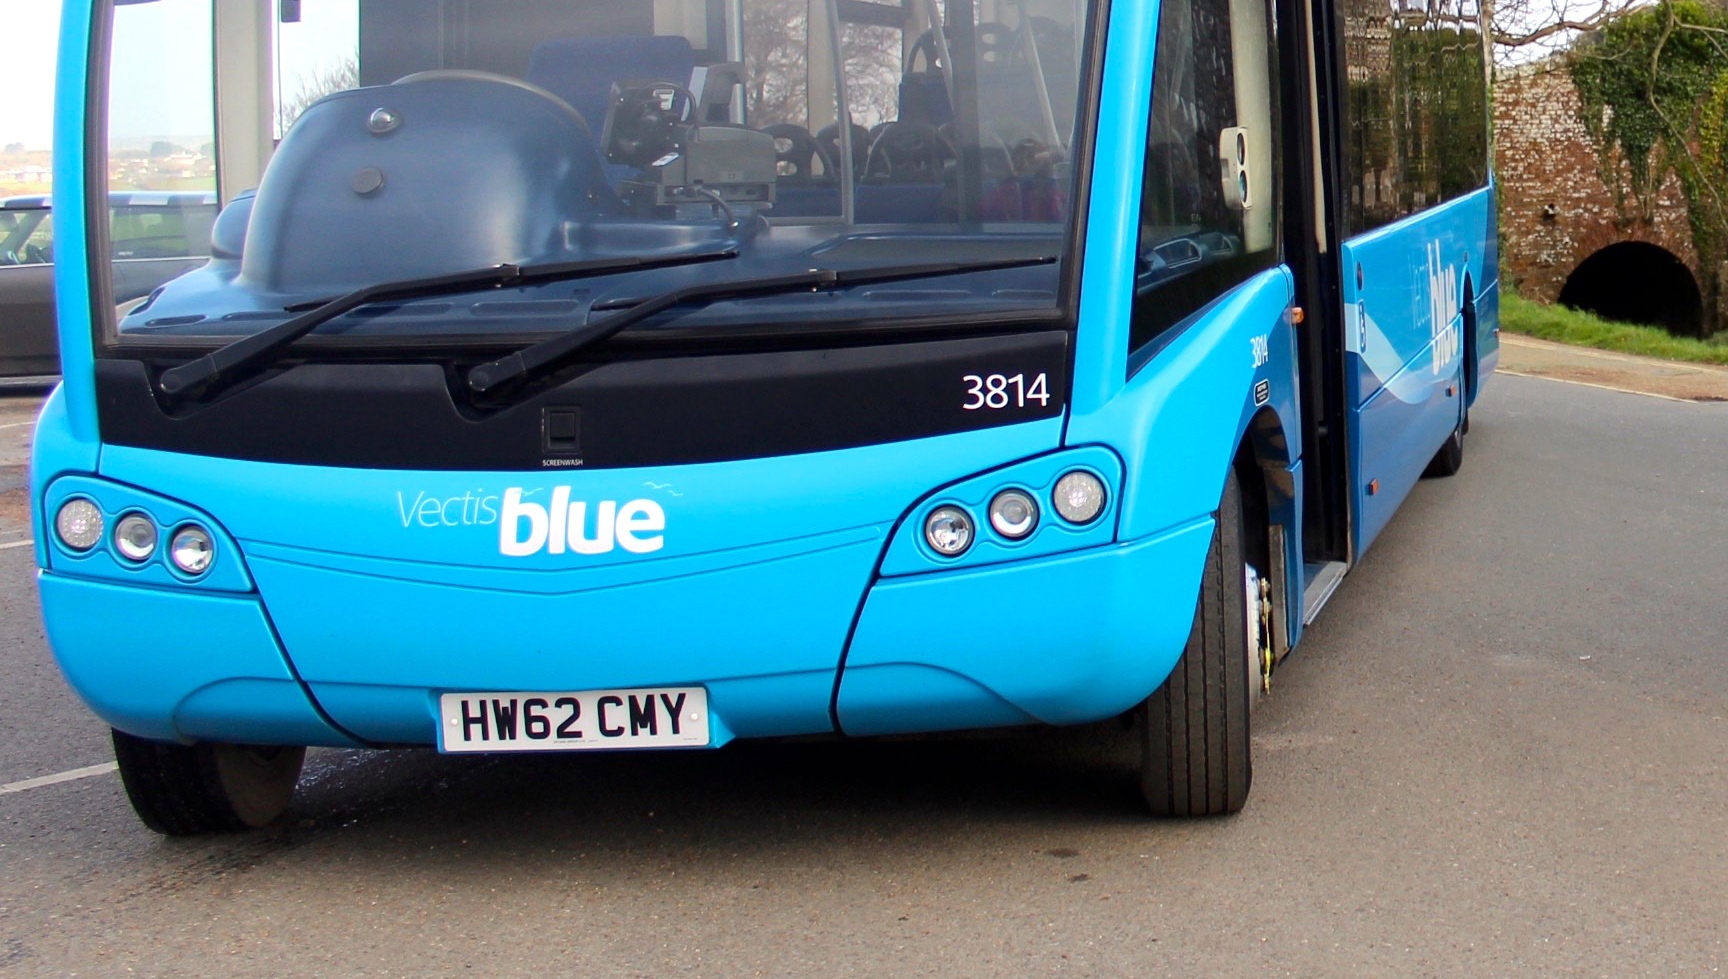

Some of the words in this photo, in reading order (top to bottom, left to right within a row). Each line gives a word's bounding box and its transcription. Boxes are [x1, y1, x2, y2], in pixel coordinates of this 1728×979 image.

[1428, 238, 1459, 375] blue
[1250, 333, 1269, 369] 3814
[962, 372, 1050, 410] 3814
[542, 458, 584, 467] SCREENWASH
[397, 487, 499, 528] Vectis
[499, 485, 666, 557] blue
[460, 697, 583, 741] HW62
[597, 693, 687, 738] CMY
